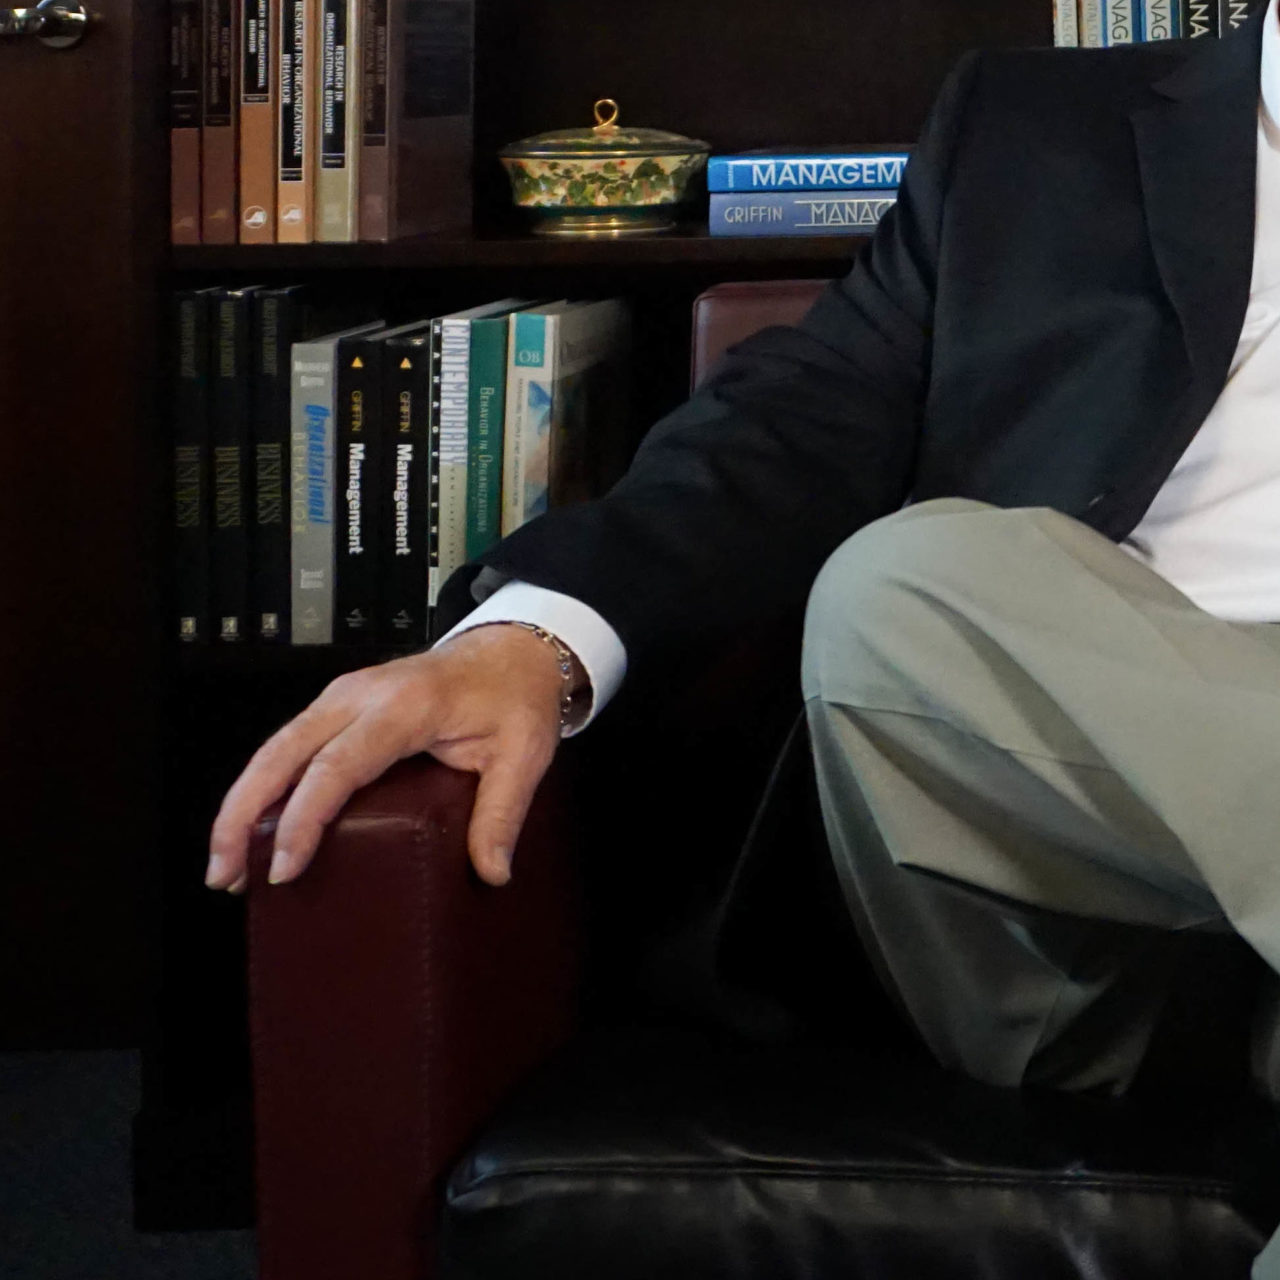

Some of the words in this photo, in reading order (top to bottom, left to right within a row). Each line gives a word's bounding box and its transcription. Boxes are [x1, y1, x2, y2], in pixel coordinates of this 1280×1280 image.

[293, 1, 303, 49] RESEARCH
[325, 12, 335, 88] ORGANIZATIONAL
[282, 54, 291, 104] BEHAVIOR
[294, 52, 303, 64] IN
[335, 46, 344, 88] RESEARCH
[293, 67, 303, 156] ORGANIZATIONAL
[325, 90, 334, 133] BEHAVIOR
[336, 91, 343, 101] IN
[725, 207, 783, 223] GRIFFIN
[480, 387, 494, 435] BEHAVIOR
[293, 433, 305, 533] BEHAVIOR
[306, 405, 330, 524] Organizational
[347, 443, 363, 554] Management
[394, 444, 413, 555] Management
[477, 455, 493, 532] ORGANIZATIONS
